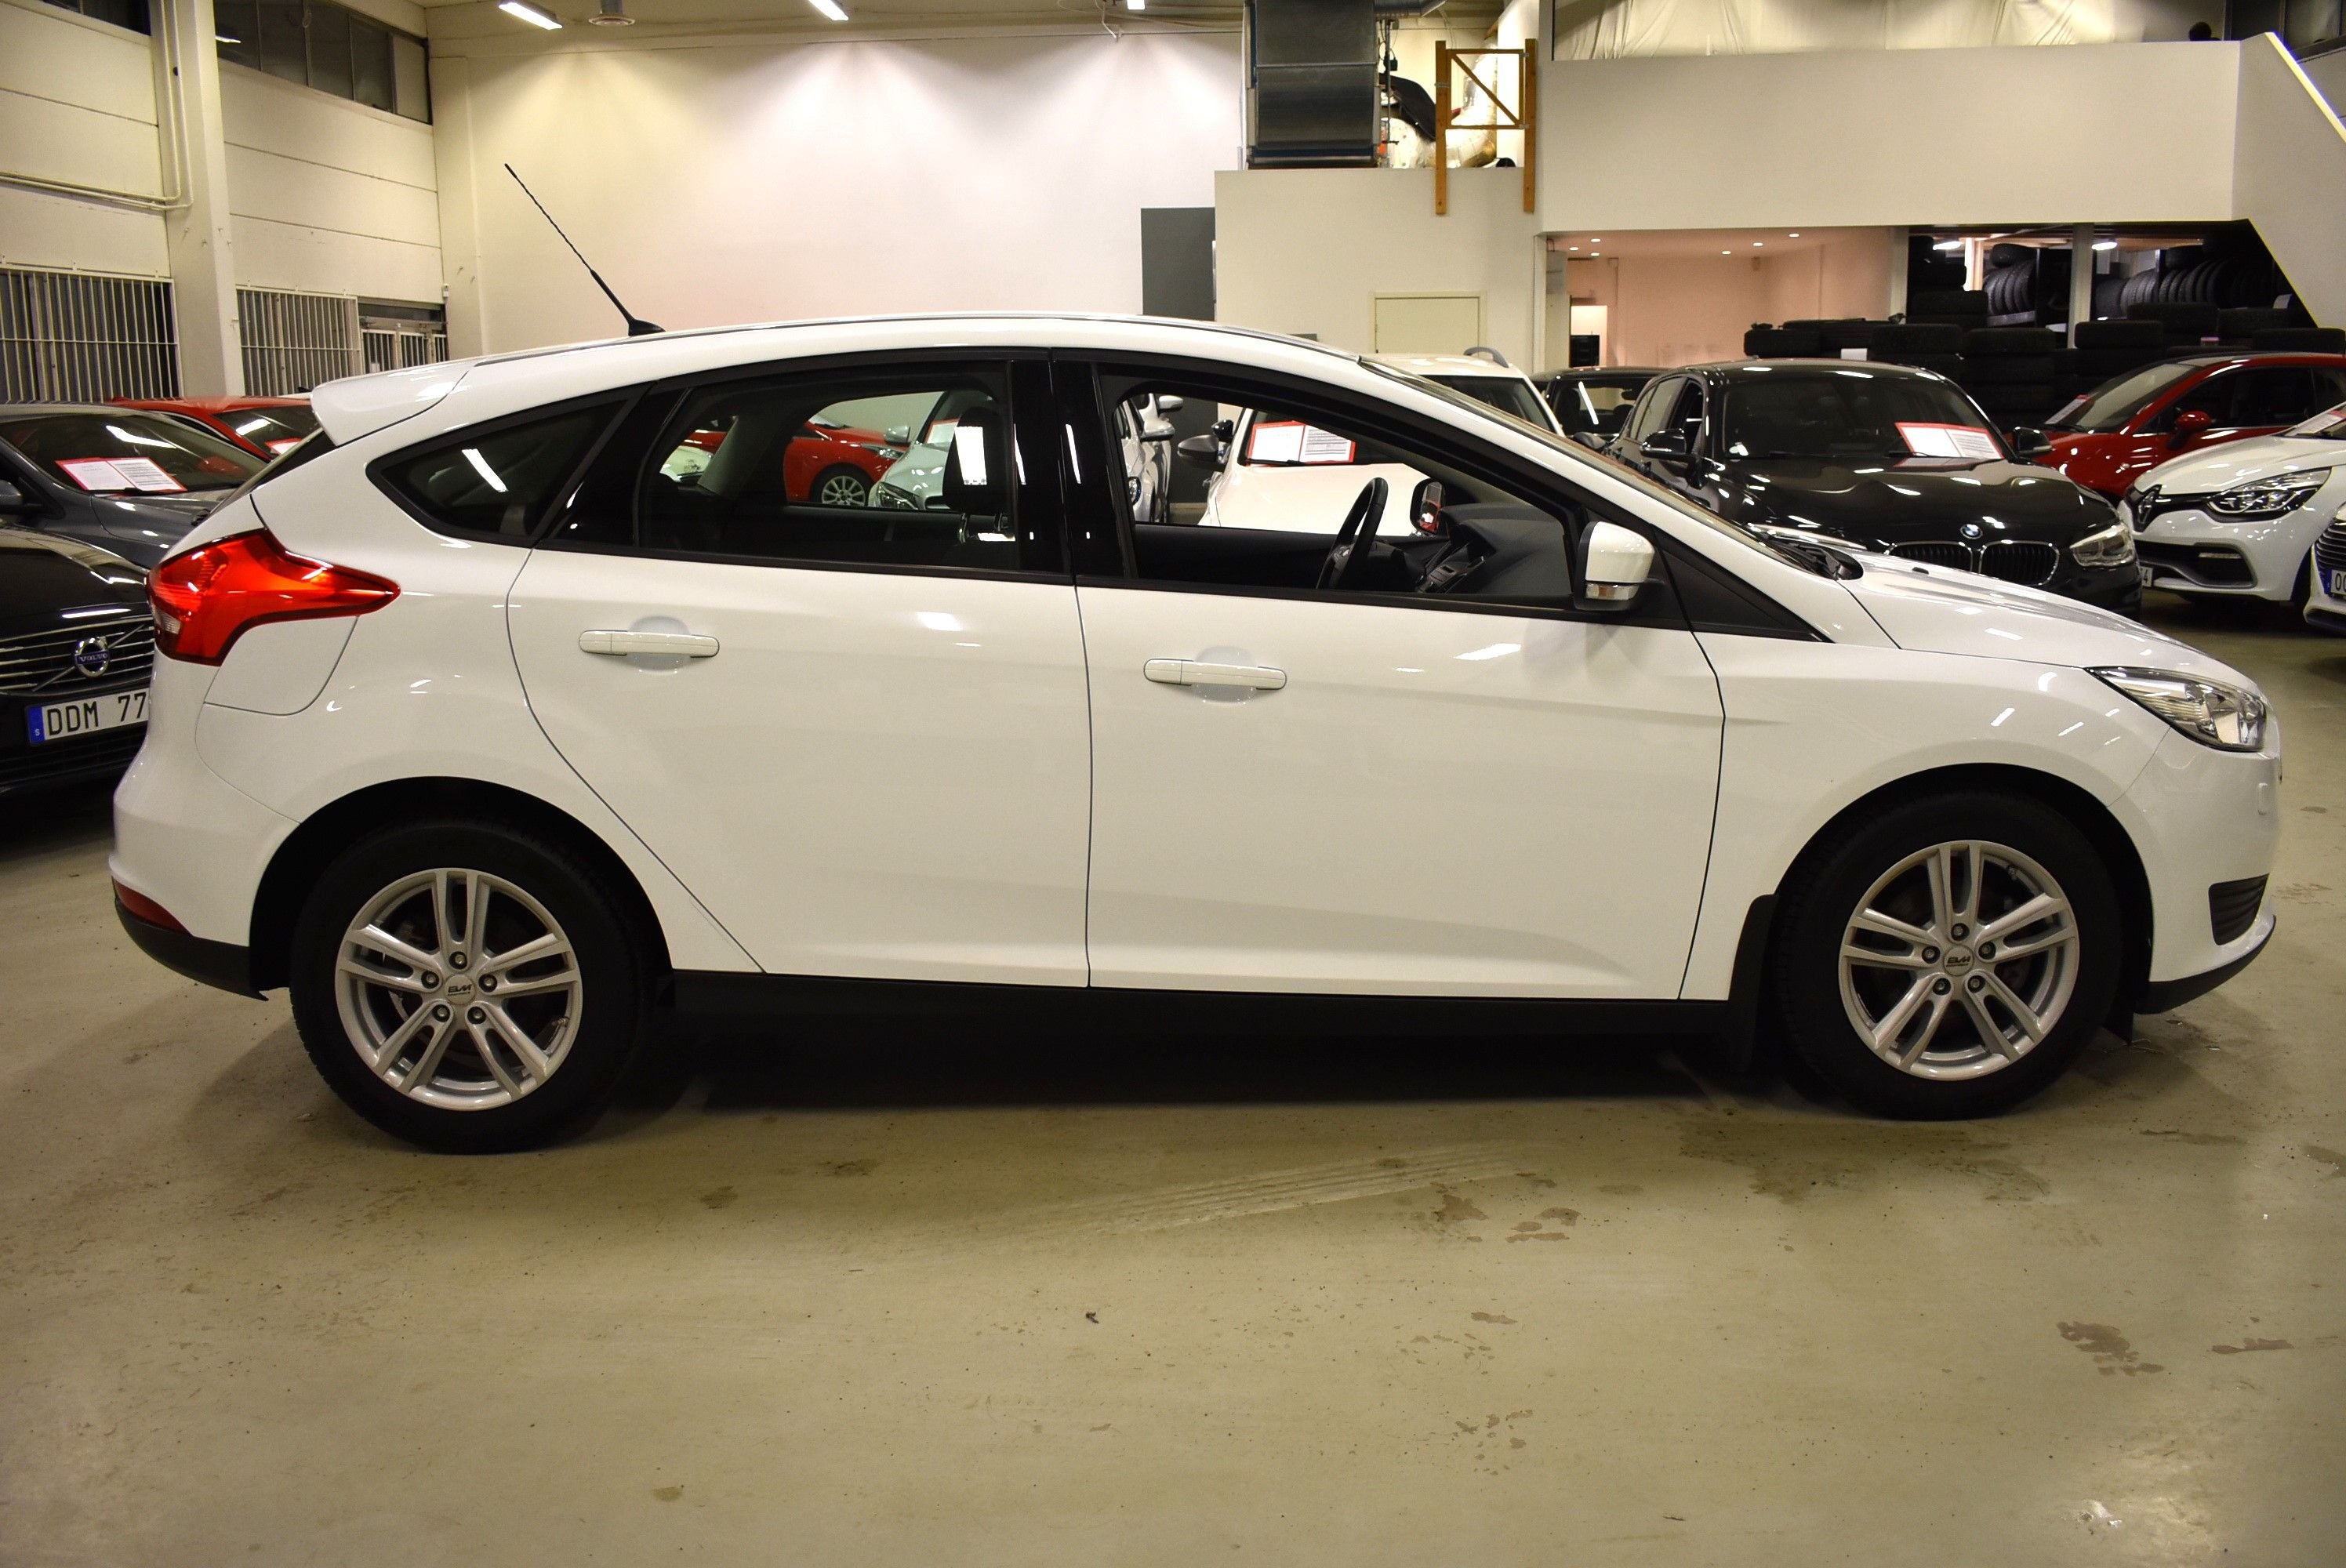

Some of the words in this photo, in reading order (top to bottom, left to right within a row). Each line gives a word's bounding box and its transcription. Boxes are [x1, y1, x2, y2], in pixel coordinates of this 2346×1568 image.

[80, 653, 108, 662] VOLVO
[47, 701, 99, 736] DDM
[118, 691, 147, 722] 77
